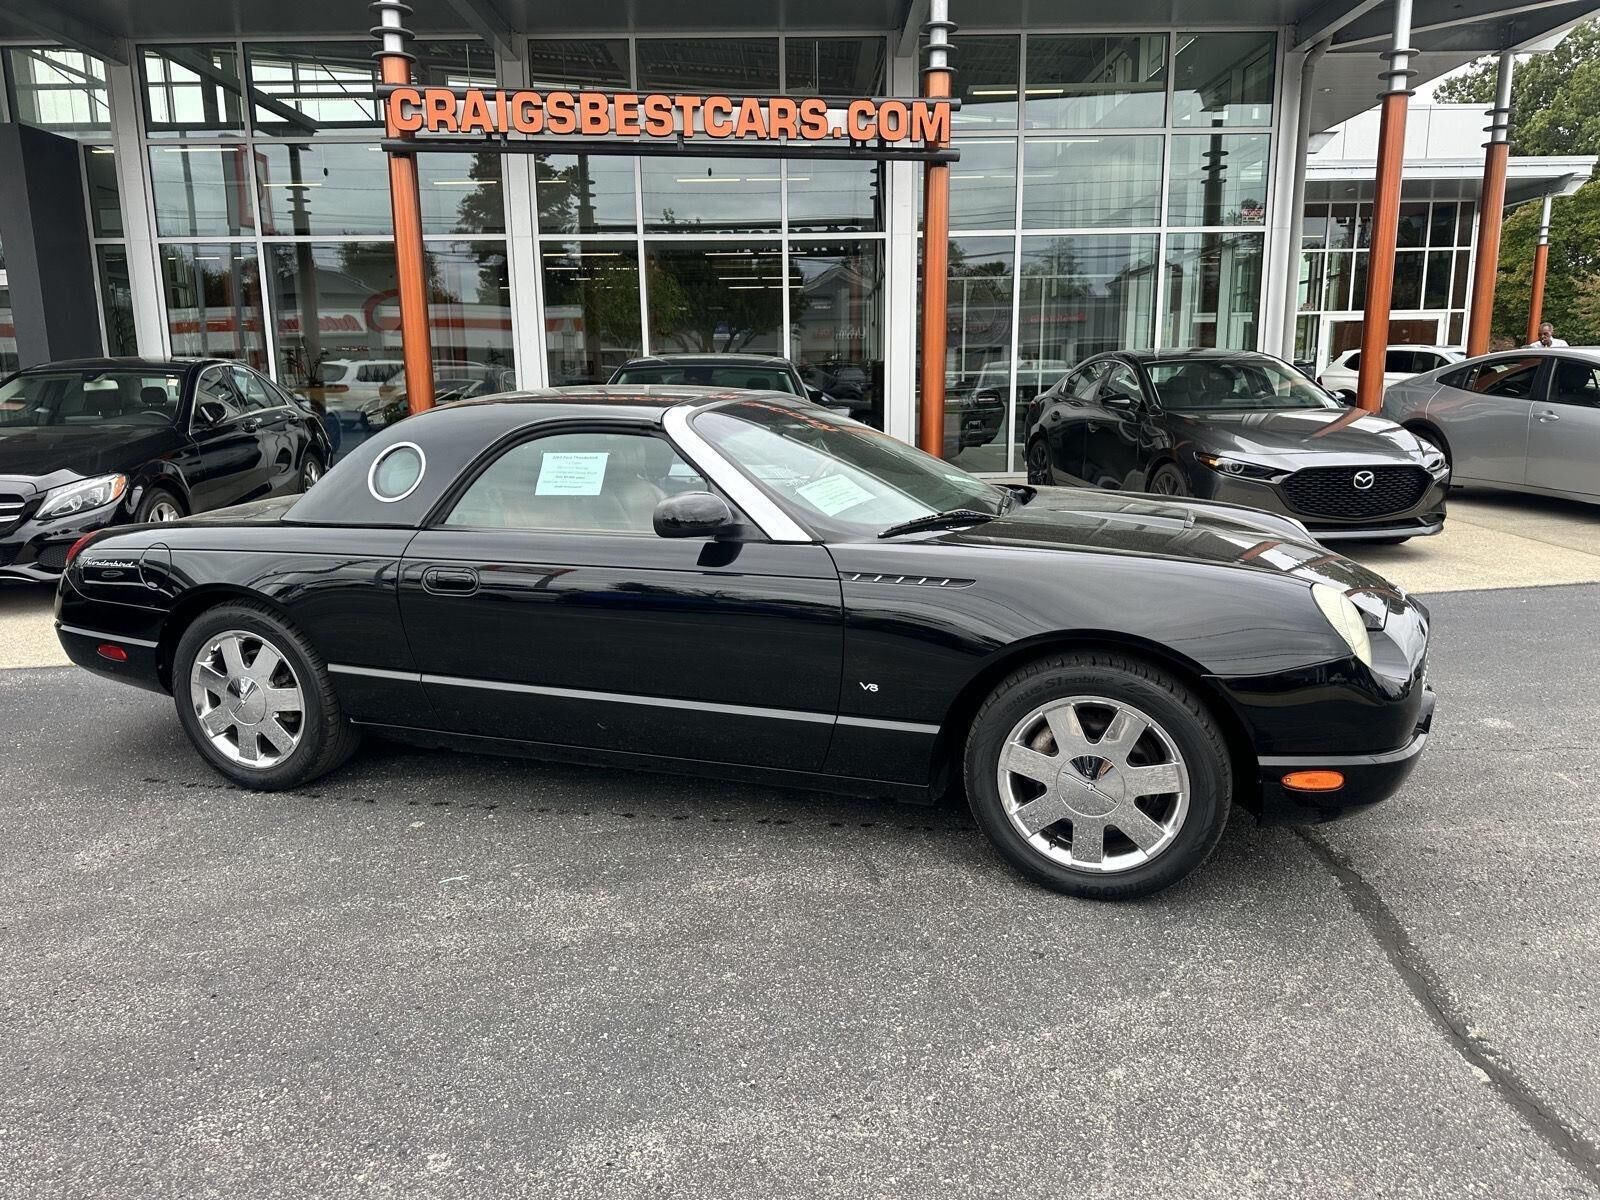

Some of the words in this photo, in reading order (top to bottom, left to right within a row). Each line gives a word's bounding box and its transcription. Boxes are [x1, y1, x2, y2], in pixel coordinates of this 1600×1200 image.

[390, 87, 951, 143] CRAIGSBESTCARS.COM
[82, 556, 136, 568] Thunderbird
[859, 681, 879, 692] V8
